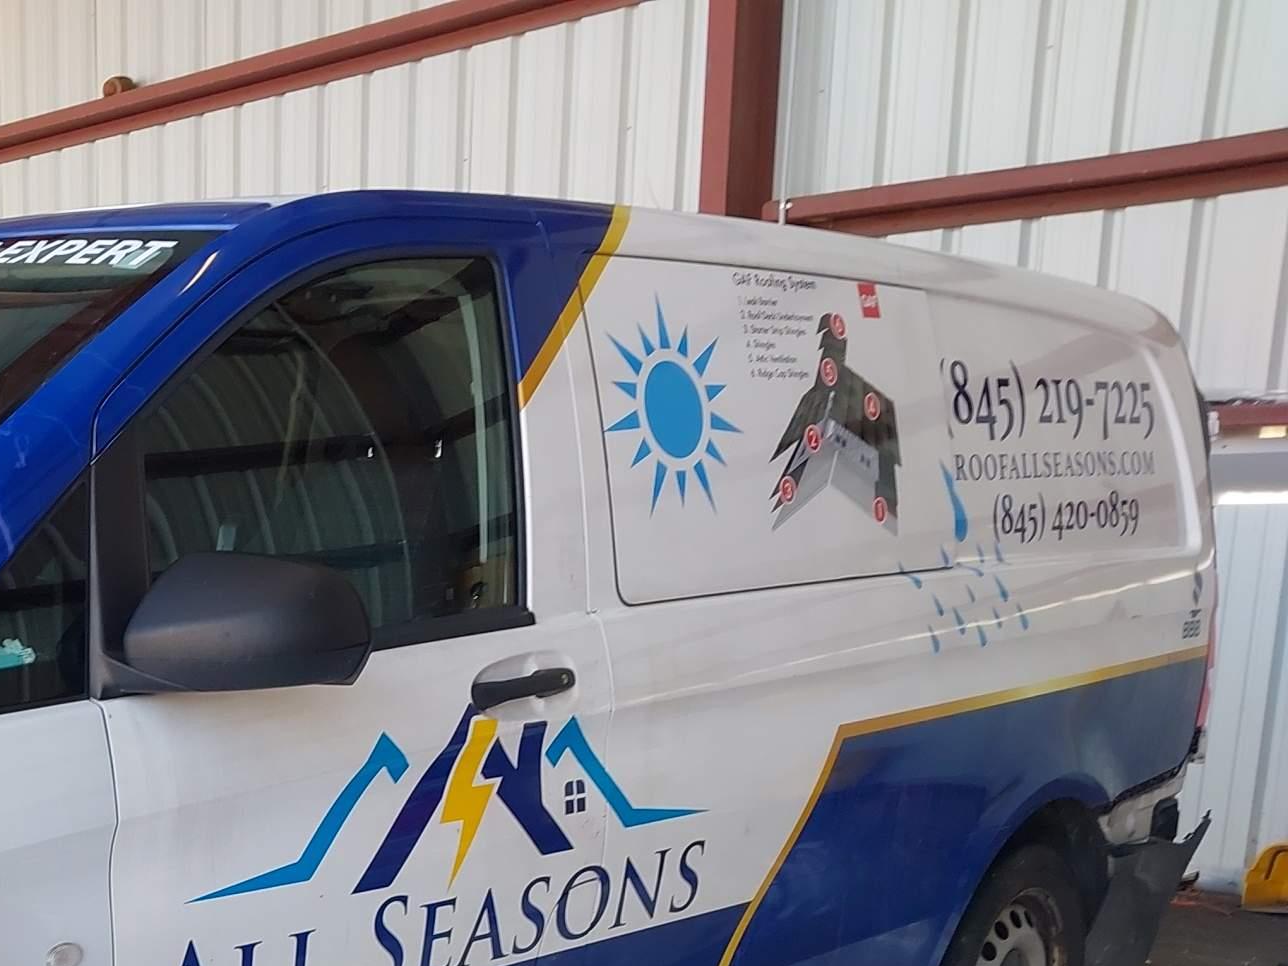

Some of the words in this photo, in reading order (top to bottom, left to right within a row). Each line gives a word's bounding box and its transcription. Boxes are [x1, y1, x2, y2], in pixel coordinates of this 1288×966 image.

[940, 358, 1026, 441] (845)
[1034, 377, 1155, 441] 219-7225
[953, 450, 1156, 482] ROOFALLSEASONS.COM
[993, 491, 1046, 543] (845)
[1051, 489, 1140, 541] 420-0859
